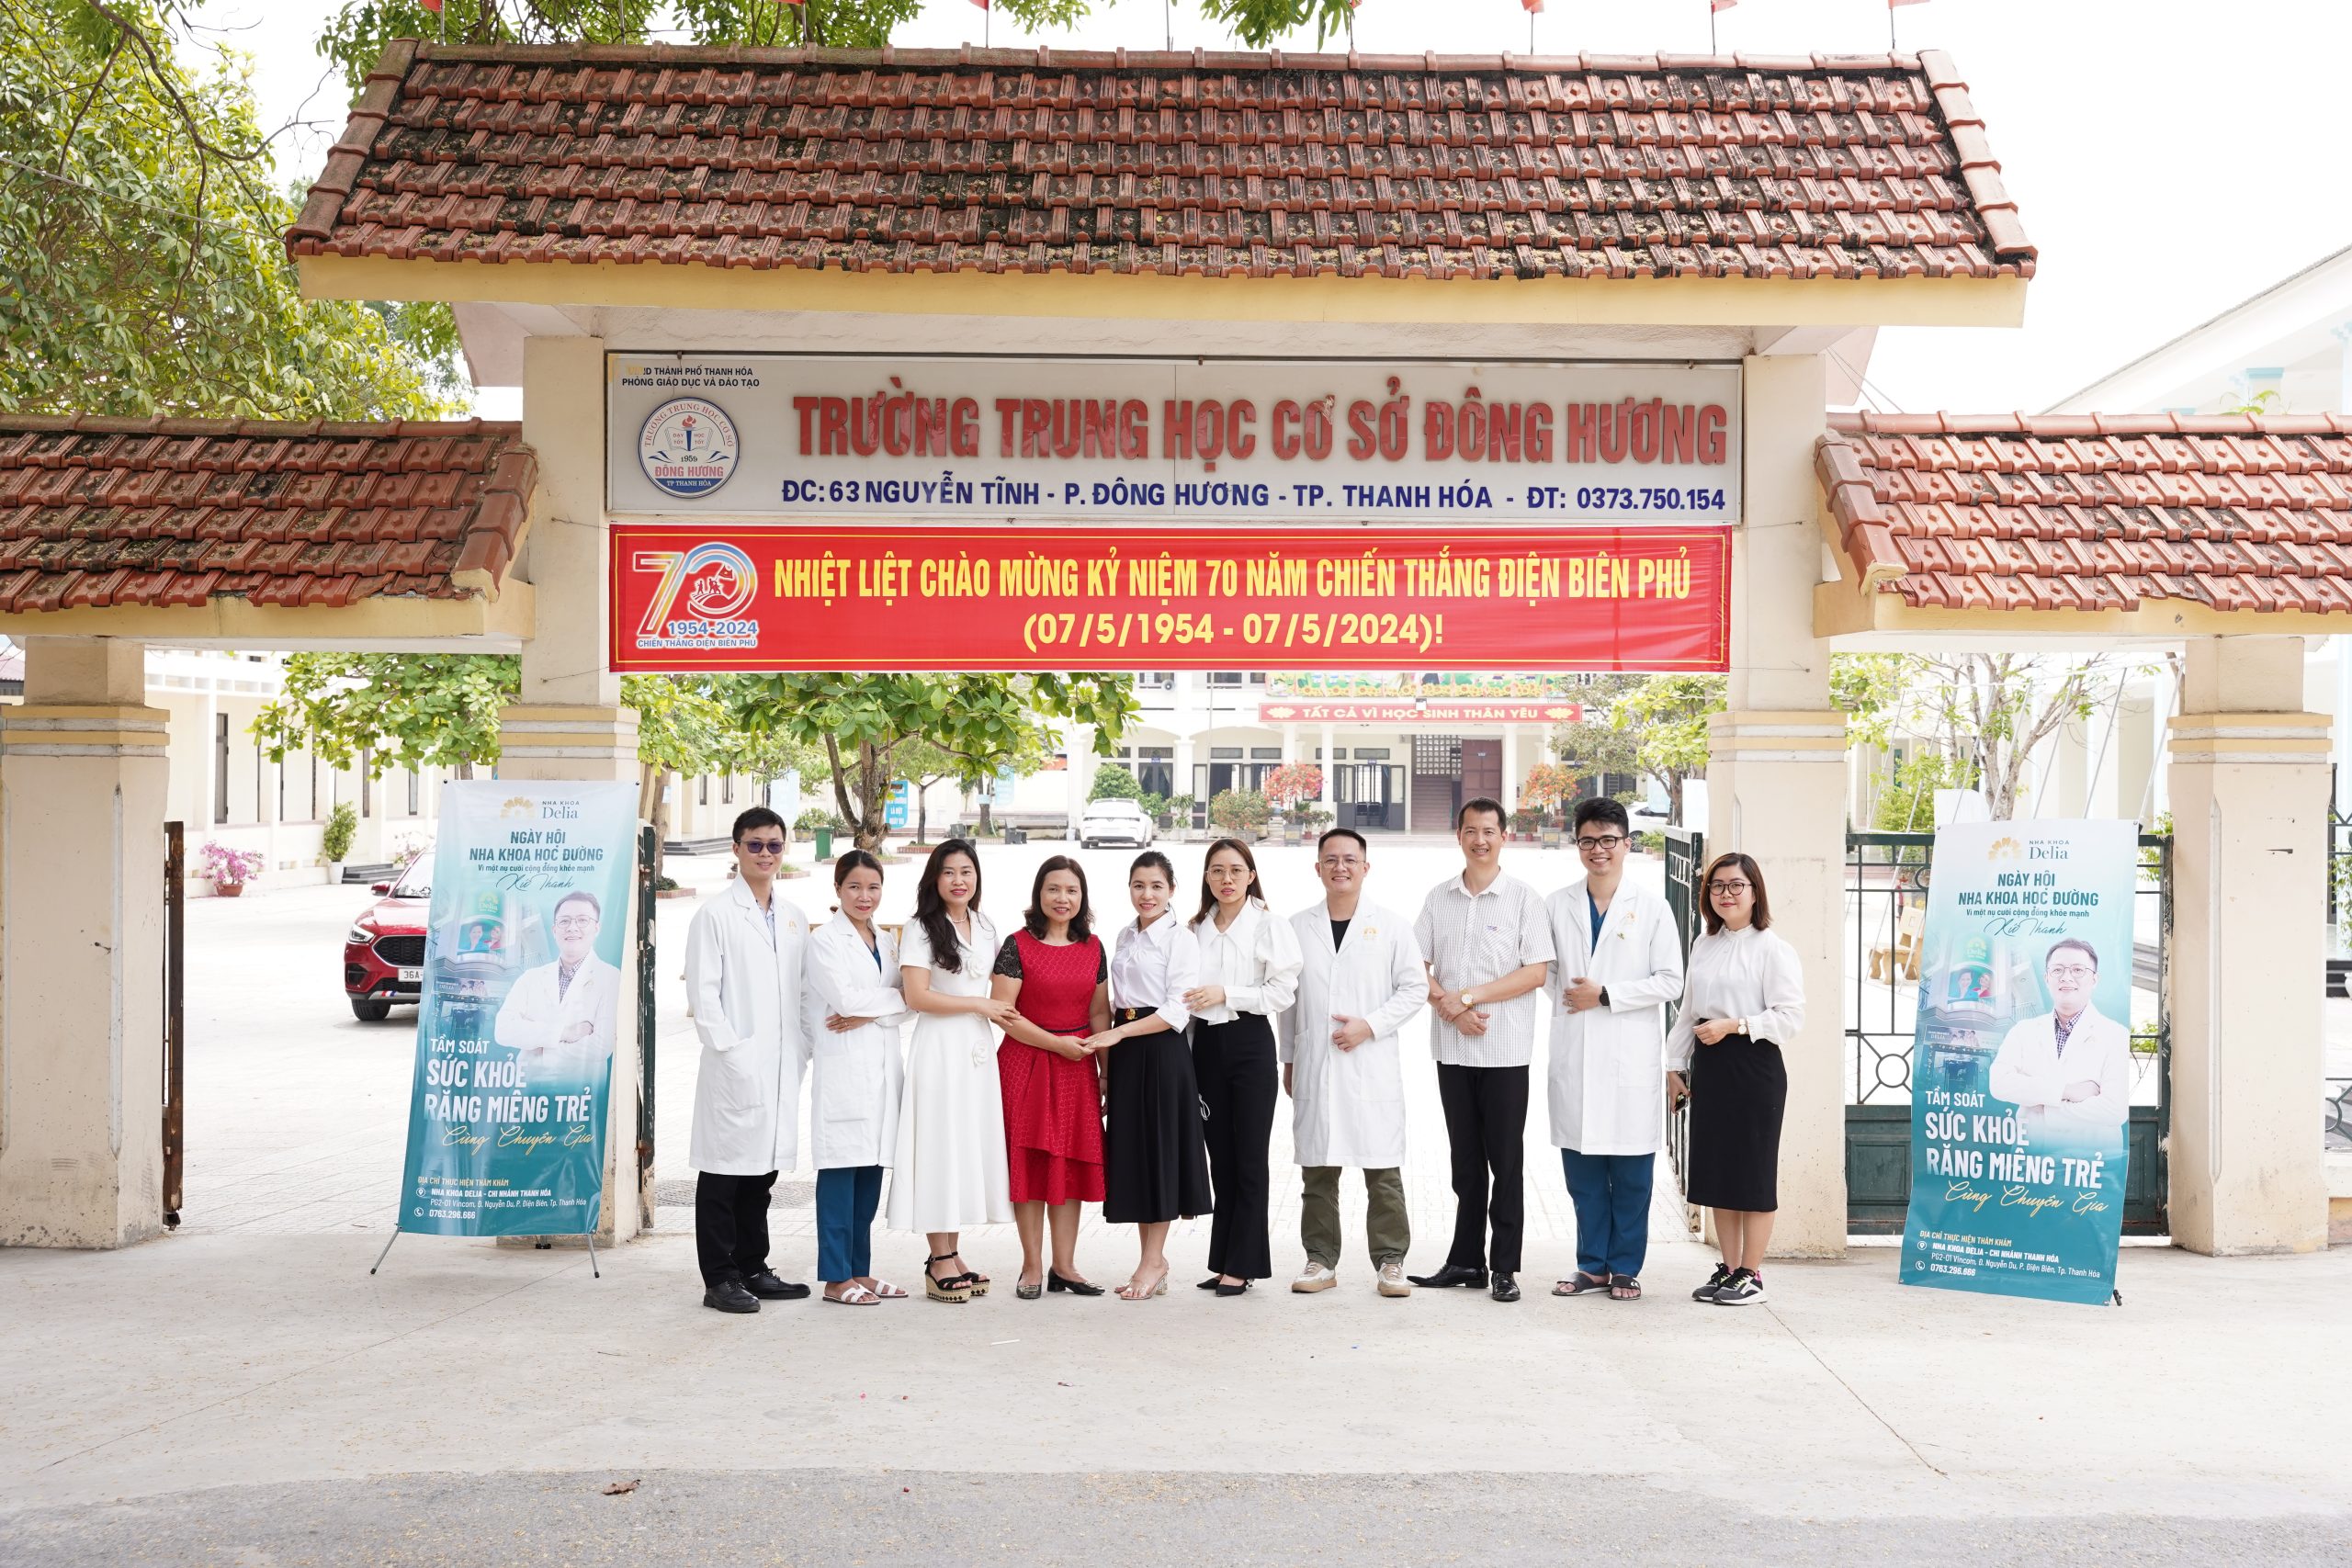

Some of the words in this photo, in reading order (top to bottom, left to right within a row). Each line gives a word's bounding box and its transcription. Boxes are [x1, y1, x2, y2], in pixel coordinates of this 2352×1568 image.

[684, 365, 703, 376] PHỐ
[705, 367, 733, 376] THANH
[735, 366, 753, 376] HÓA
[656, 376, 679, 387] GIÁO
[682, 378, 701, 389] DỤC
[741, 378, 760, 389] TẠO
[667, 403, 700, 414] TRUNG
[702, 406, 721, 422] HỌC
[793, 378, 979, 457] TRƯỜNG
[996, 397, 1148, 459] TRUNG
[1163, 400, 1257, 472] HỌC
[1273, 395, 1336, 460] CƠ
[1348, 377, 1410, 460] SỞ
[1424, 387, 1554, 464] ĐÔNG
[1567, 397, 1726, 465] HƯƠNG
[681, 455, 698, 463] 1959
[654, 464, 684, 478] ĐÔNG
[687, 465, 724, 478] HƯƠNG
[865, 470, 974, 505] NGUYỄN
[980, 476, 1038, 505] TĨNH
[1064, 483, 1086, 505] P.
[1092, 478, 1165, 506] ĐÔNG
[1175, 481, 1270, 507] HƯƠNG
[1294, 484, 1332, 508] TP.
[1343, 485, 1430, 508] THANH
[1438, 479, 1493, 509] HÓA
[1527, 487, 1566, 509] ĐT:
[1577, 488, 1726, 511] 0373.750.154
[775, 551, 850, 607] NHIỆT
[859, 551, 913, 607] LIỆT
[920, 551, 989, 598] CHÀO
[1000, 550, 1079, 598] MỪNG
[1087, 546, 1124, 597] KỶ
[1129, 551, 1198, 607] NIỆM
[1205, 558, 1238, 597] 70
[1246, 550, 1308, 597] NĂM
[1316, 547, 1396, 598] CHIẾN
[1404, 546, 1491, 599] THẮNG
[1498, 551, 1560, 607] ĐIỆN
[1568, 552, 1630, 599] BIÊN
[1638, 547, 1690, 600] PHỦ
[668, 621, 758, 636] 1954-2024
[1023, 613, 1214, 653] (07/5/1954
[1243, 613, 1443, 654] 07/5/2024)!
[718, 637, 737, 647] BIÊN
[1302, 705, 1330, 718] TẤT
[1333, 705, 1358, 718] CẢ
[1362, 705, 1377, 718] VÌ
[1382, 709, 1419, 721] HỌC
[1422, 709, 1459, 718] SINH
[1464, 707, 1505, 718] THÂN
[1510, 706, 1539, 718] YÊU
[542, 806, 579, 819] Delia
[510, 828, 543, 844] NGÀY
[546, 829, 566, 848] HỘI
[469, 848, 494, 861] NHA
[498, 848, 531, 862] KHOA
[534, 848, 559, 865] HỌC
[562, 845, 604, 862] ĐƯỜNG
[2029, 845, 2069, 860] Delia
[485, 864, 499, 874] một
[500, 865, 508, 874] nụ
[525, 864, 541, 874] cộng
[576, 864, 594, 874] mạnh
[1997, 869, 2030, 886] NGÀY
[2033, 869, 2055, 891] HỘI
[1958, 892, 1983, 906] NHA
[1985, 891, 2018, 905] KHOA
[2022, 891, 2049, 909] HỌC
[2052, 888, 2099, 907] ĐƯỜNG
[1973, 908, 1986, 918] một
[1987, 909, 1996, 918] nụ
[2012, 908, 2030, 918] cộng
[2069, 909, 2089, 919] mạnh
[2018, 918, 2067, 937] Thanh
[430, 1033, 455, 1055] TẦM
[458, 1036, 491, 1055] SOÁT
[426, 1052, 469, 1088] SỨC
[473, 1052, 528, 1089] KHỎE
[1925, 1085, 1951, 1106] TẦM
[1953, 1089, 1985, 1109] SOÁT
[424, 1090, 481, 1123] RĂNG
[486, 1089, 549, 1130] MIỆNG
[554, 1086, 592, 1122] TRẺ
[1925, 1105, 1966, 1142] SỨC
[1973, 1108, 2030, 1146] KHỎE
[442, 1124, 490, 1156] Cùng
[497, 1124, 558, 1156] Chuyên
[562, 1124, 595, 1150] Gia
[1926, 1142, 1984, 1179] RĂNG
[1988, 1147, 2055, 1190] MIỆNG
[2062, 1151, 2105, 1190] TRẺ
[1944, 1179, 1993, 1213] Cùng
[2000, 1185, 2064, 1218] Chuyên
[2071, 1190, 2109, 1217] Gia
[429, 1209, 476, 1220] 0763.296.666
[1919, 1230, 1931, 1240] ĐỊA
[1931, 1230, 1942, 1240] CHỈ
[1943, 1232, 1960, 1243] THỰC
[1961, 1235, 1976, 1246] HIỆN
[1995, 1236, 2012, 1247] KHÁM
[1932, 1242, 1946, 1251] NHA
[1947, 1244, 1965, 1254] KHOA
[1965, 1246, 1984, 1256] DELIA
[1989, 1248, 2000, 1258] CHI
[2000, 1247, 2023, 1259] NHÁNH
[2023, 1251, 2045, 1262] THANH
[2045, 1252, 2060, 1264] HÓA
[1930, 1263, 1976, 1277] 0763.296.666
[1985, 1258, 2007, 1270] Nguyễn
[2068, 1267, 2087, 1277] Thanh
[2088, 1268, 2100, 1279] Hóa
